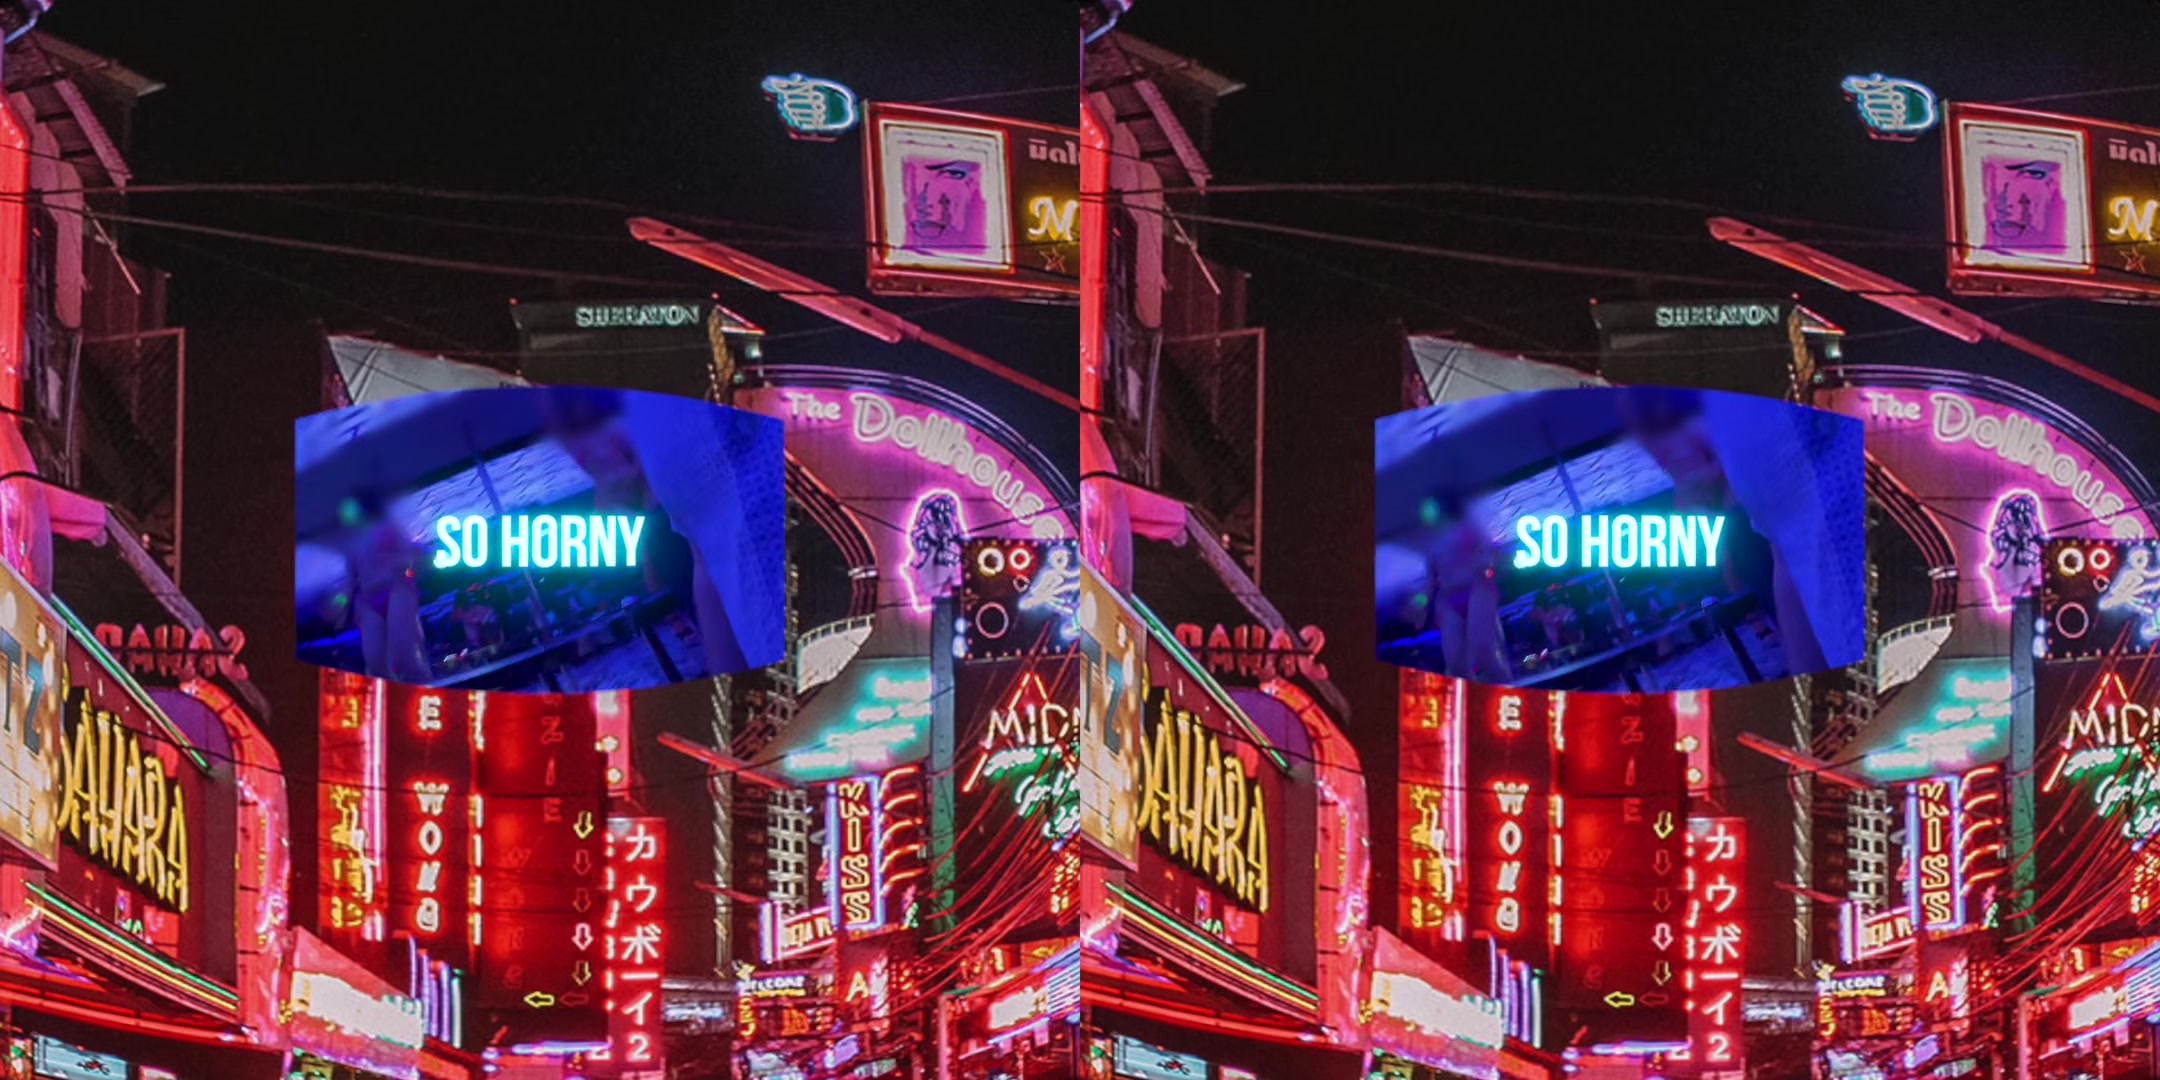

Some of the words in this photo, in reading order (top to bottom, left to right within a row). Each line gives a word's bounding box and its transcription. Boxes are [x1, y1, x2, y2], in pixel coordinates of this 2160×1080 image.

[575, 304, 700, 328] SHERATON
[1655, 304, 1780, 328] SHERATON
[782, 391, 842, 421] The
[1862, 391, 1922, 421] The
[839, 782, 871, 923] KISS
[1919, 782, 1951, 923] KISS
[620, 823, 663, 1062] カウボーイ2
[1700, 823, 1743, 1062] カウボーイ2
